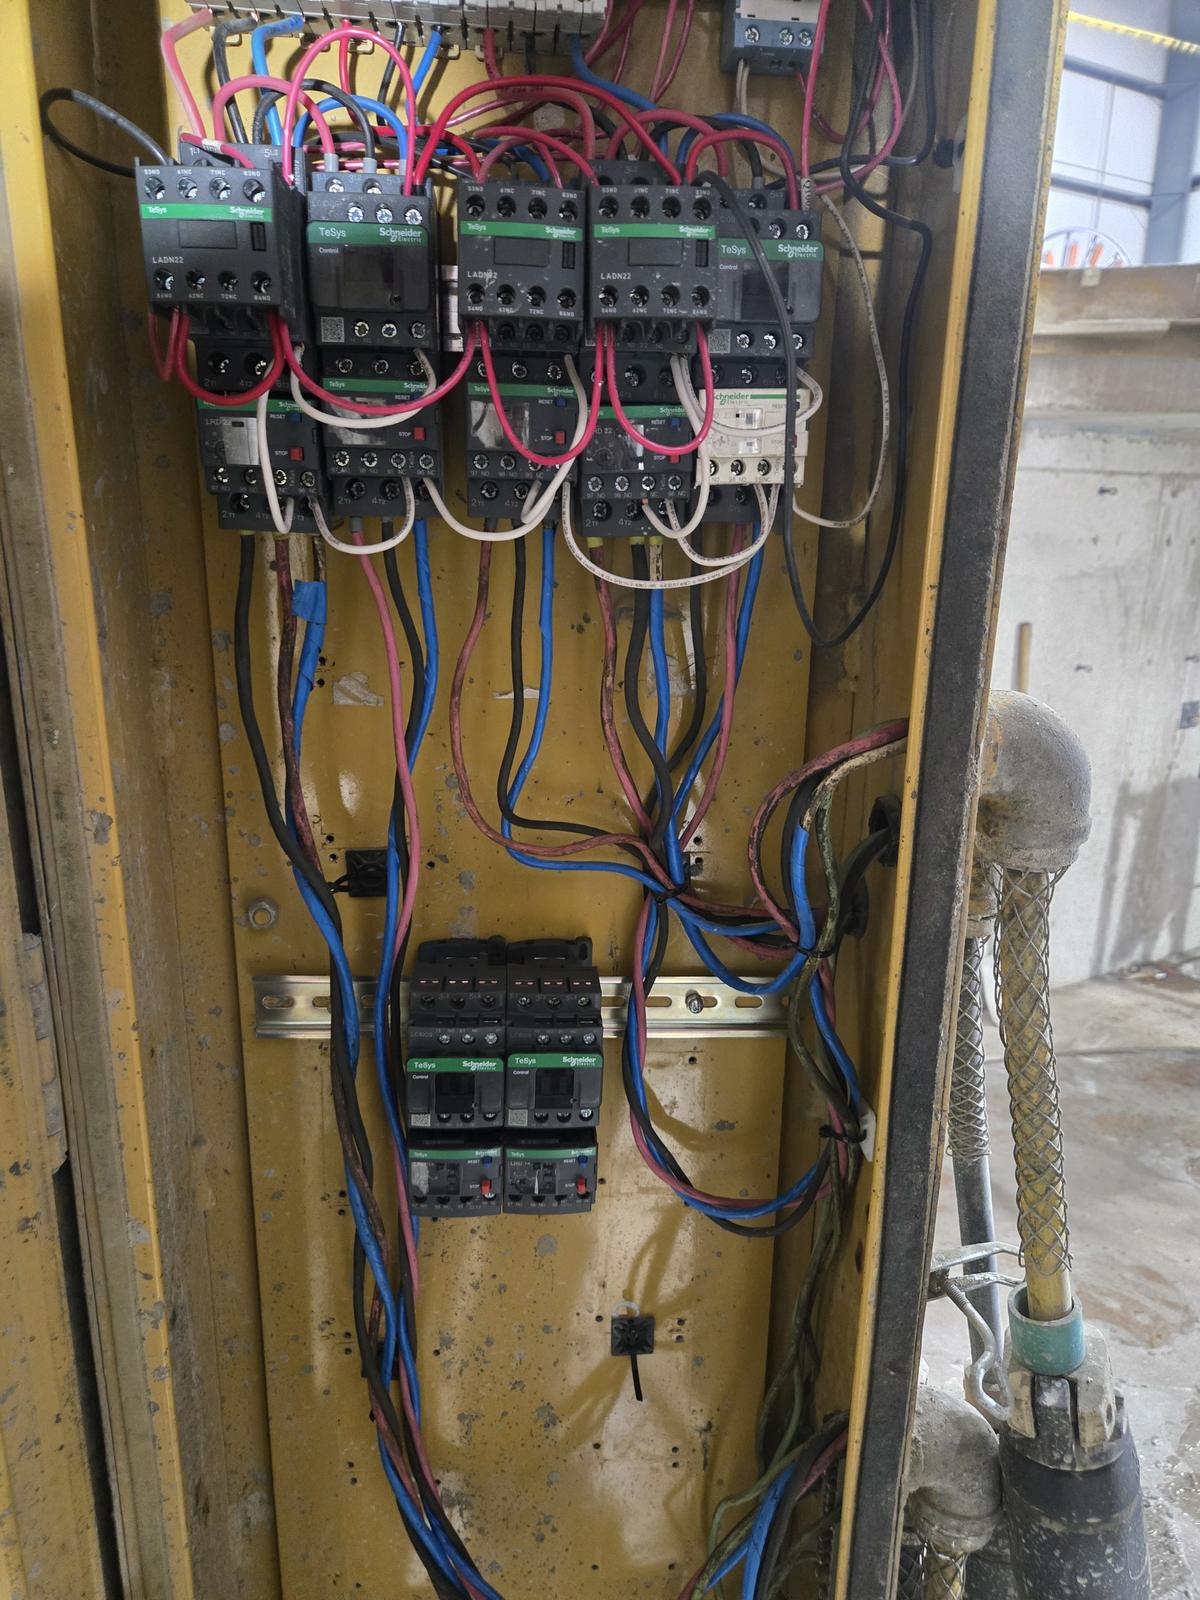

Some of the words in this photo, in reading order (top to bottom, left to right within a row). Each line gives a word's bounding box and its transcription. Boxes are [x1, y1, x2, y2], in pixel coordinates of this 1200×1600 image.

[147, 206, 168, 214] TeSys
[229, 206, 265, 218] Schneider
[318, 226, 346, 239] TeSys
[378, 228, 423, 242] Schneider
[467, 222, 487, 232] TeSys
[544, 226, 577, 238] Schneider
[600, 226, 620, 234] TeSys
[678, 226, 710, 237] Schneider
[720, 244, 747, 255] TeSys
[778, 244, 818, 258] Schneider
[152, 256, 184, 264] LADN22
[467, 271, 498, 279] LADN22
[714, 392, 750, 406] chneider
[414, 1062, 436, 1070] TeSys
[462, 1060, 497, 1071] Schneider
[514, 1057, 537, 1066] TeSys
[562, 1056, 597, 1067] Schneider
